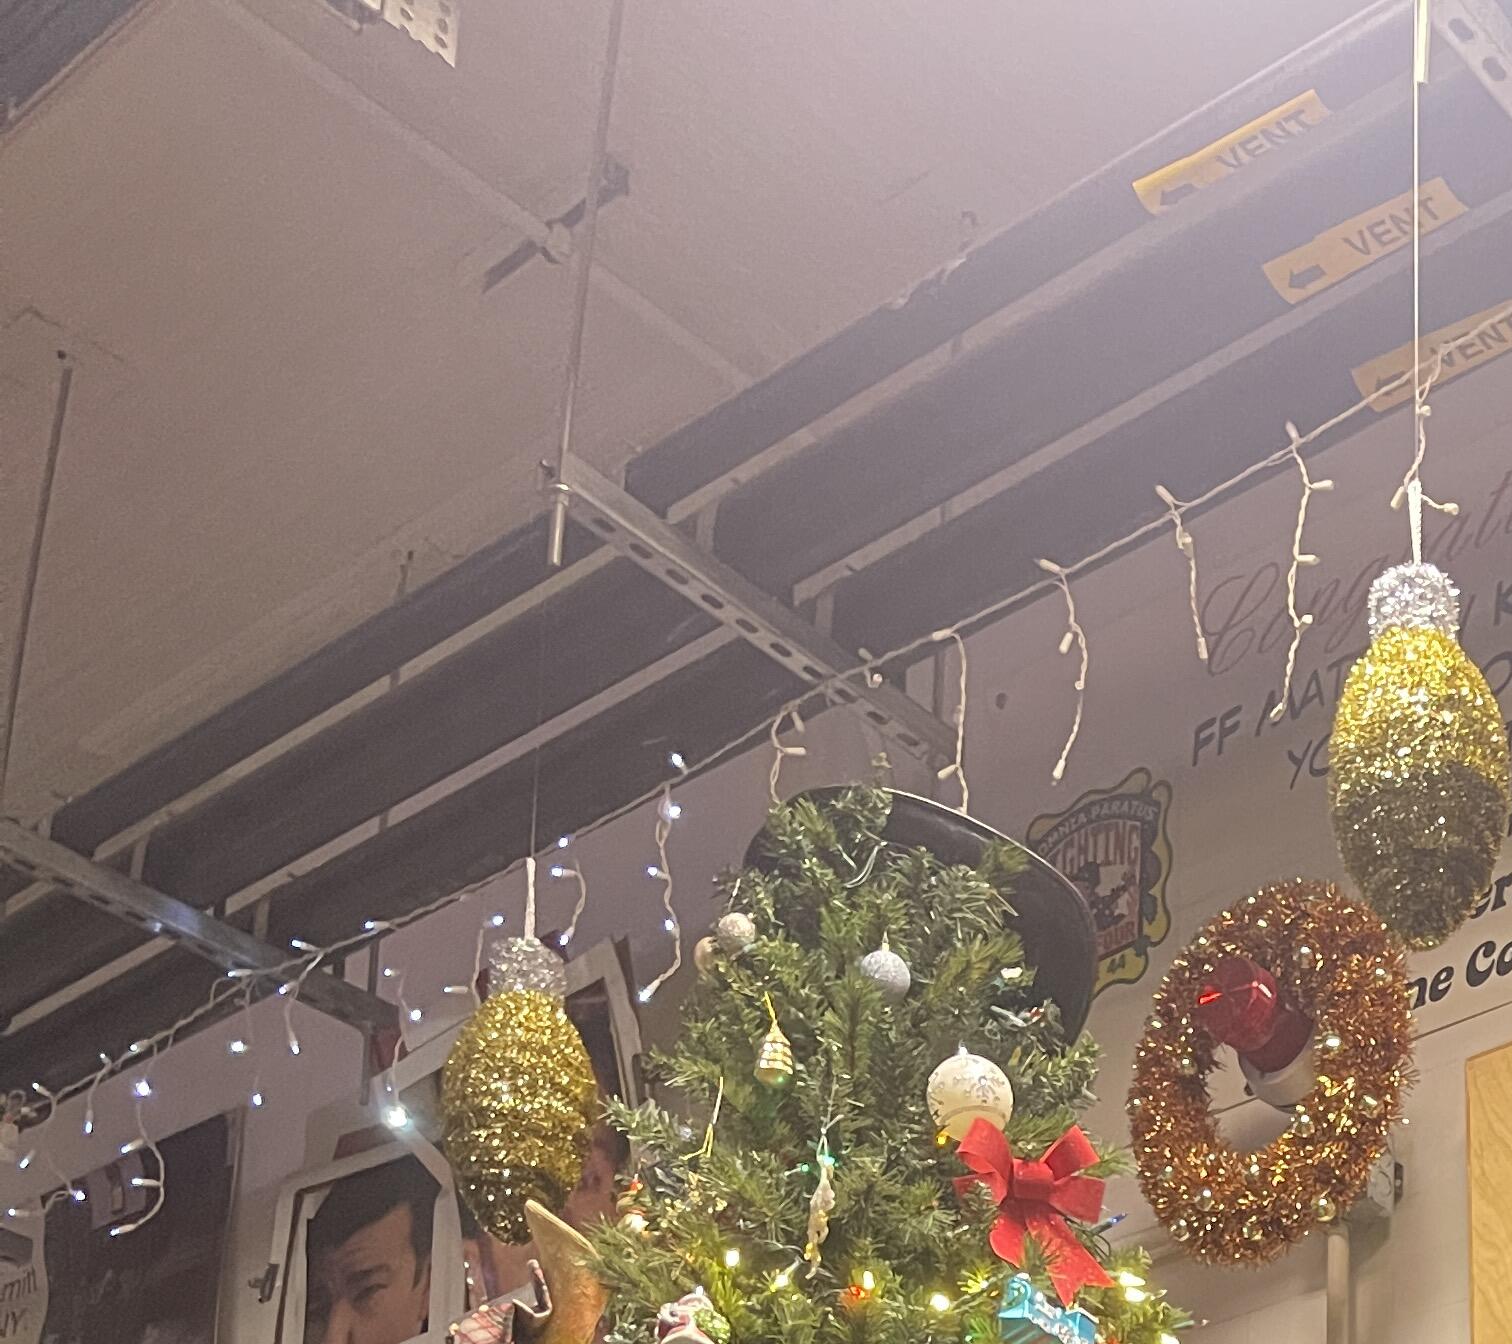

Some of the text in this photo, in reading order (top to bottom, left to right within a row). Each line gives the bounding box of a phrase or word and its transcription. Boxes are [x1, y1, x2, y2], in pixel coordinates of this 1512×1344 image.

[1215, 109, 1318, 170] VENT
[1341, 197, 1441, 257] VENT
[1192, 705, 1243, 767] FF
[1090, 800, 1158, 821] PARATUS
